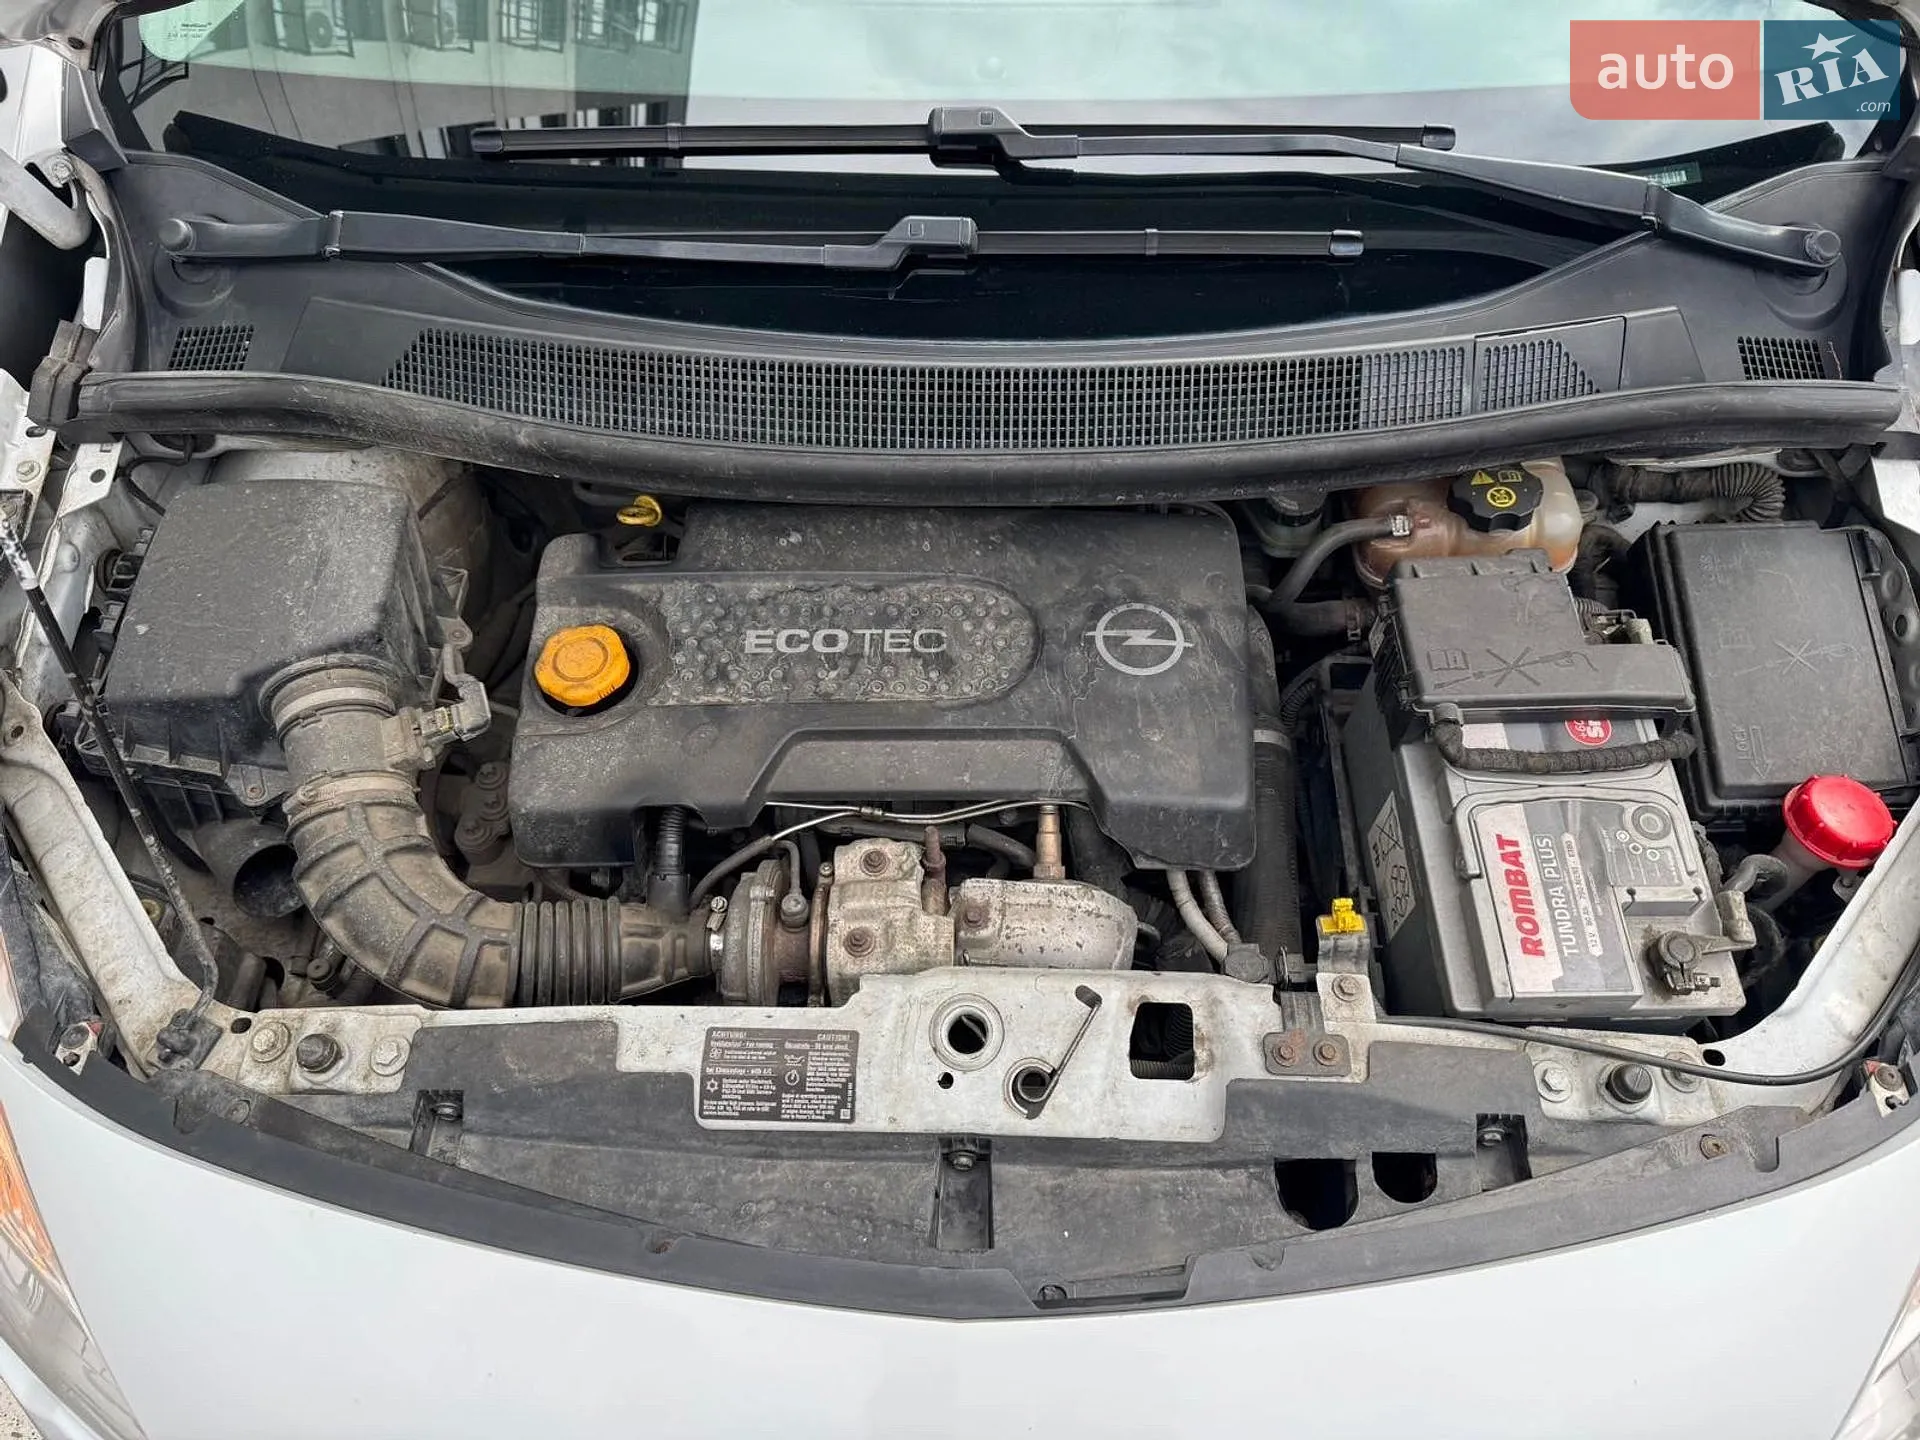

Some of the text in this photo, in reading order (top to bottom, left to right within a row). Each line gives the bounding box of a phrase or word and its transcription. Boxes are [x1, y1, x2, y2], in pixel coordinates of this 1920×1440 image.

[744, 628, 947, 653] ECOTEC
[1537, 837, 1560, 881] PLUS
[1496, 833, 1545, 957] ROMBAT
[1549, 887, 1579, 957] TUNDRA
